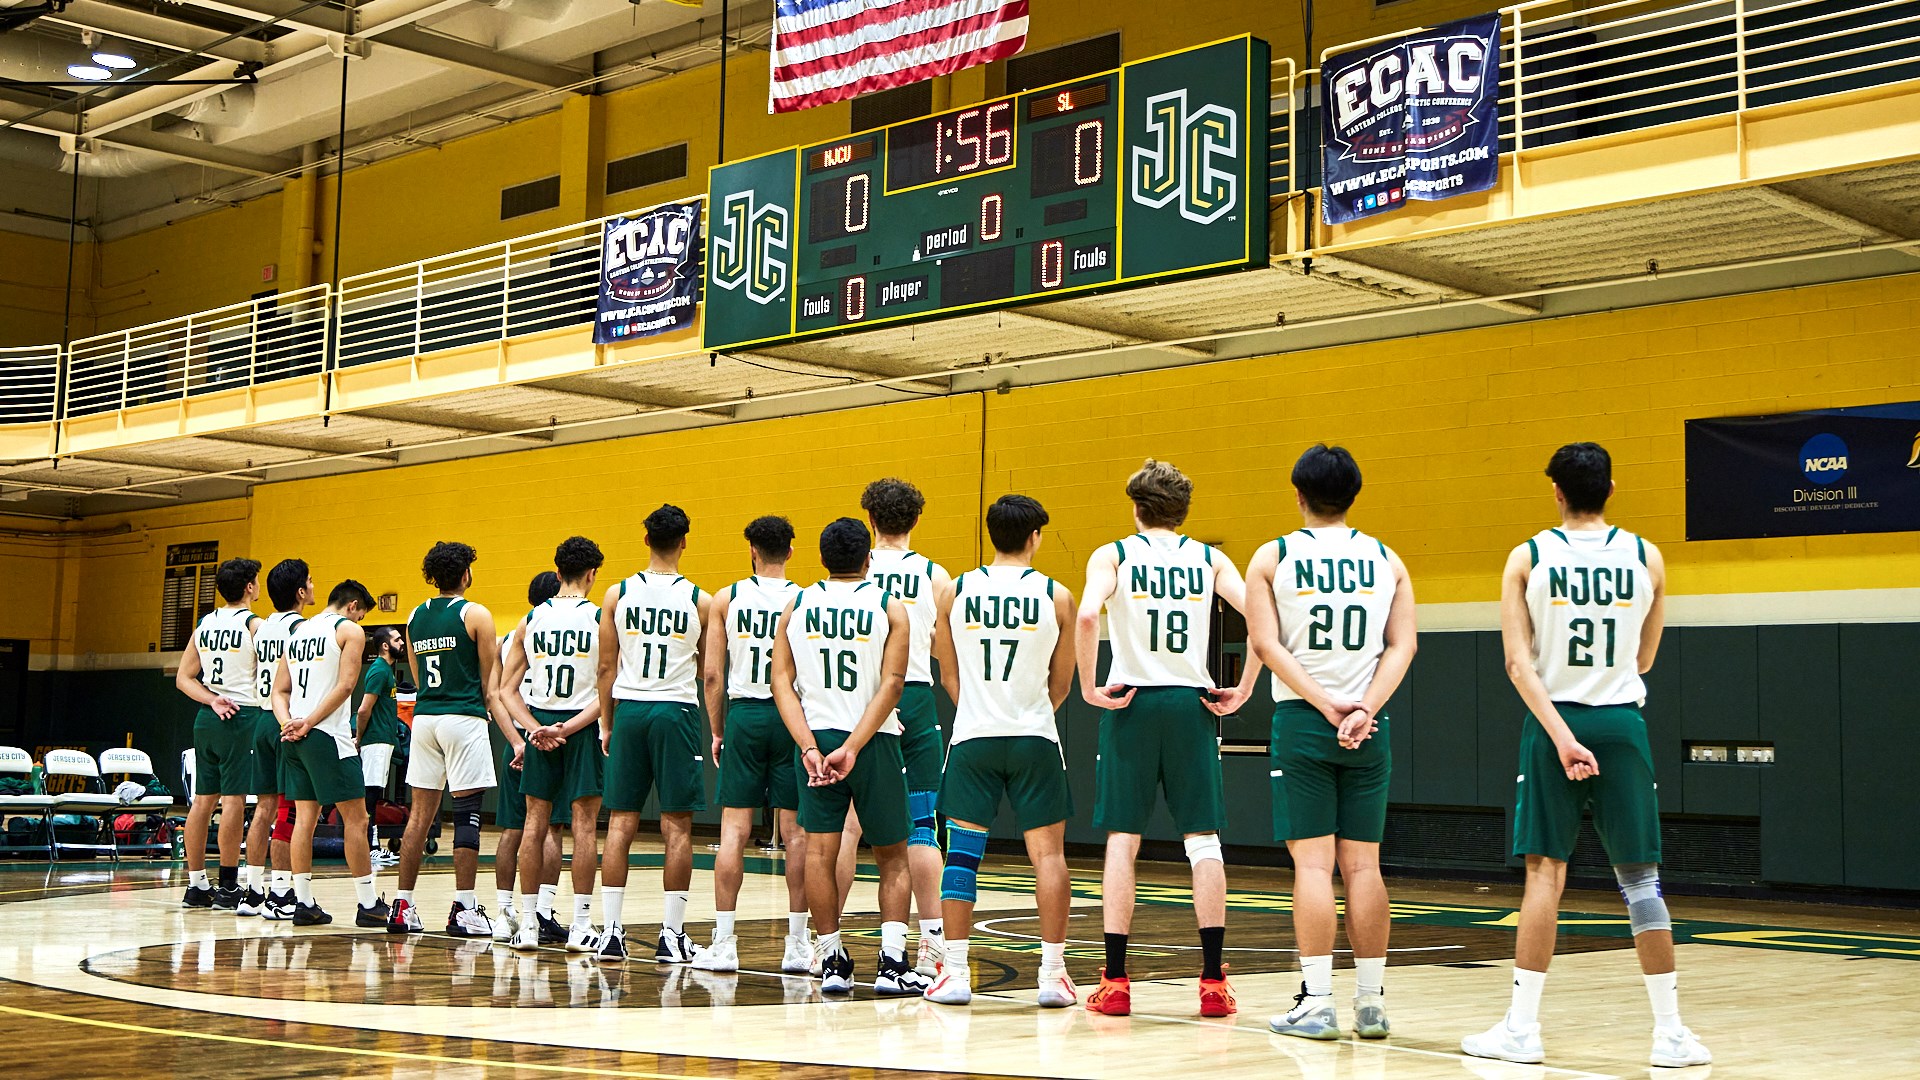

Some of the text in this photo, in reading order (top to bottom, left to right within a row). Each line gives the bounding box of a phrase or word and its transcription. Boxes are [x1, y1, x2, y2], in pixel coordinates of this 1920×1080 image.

[1057, 92, 1074, 112] SL
[1335, 42, 1482, 130] ECAC
[1346, 115, 1376, 137] EASTERN
[1376, 104, 1403, 121] COLLEGE
[936, 103, 1011, 174] 1:56
[1074, 120, 1102, 186] 0
[1362, 146, 1386, 155] HOME
[1404, 126, 1457, 144] AMPIONS
[824, 145, 852, 168] NJCU
[1132, 88, 1237, 225] JC
[1330, 146, 1488, 196] WWW.ECASPORTS.COM
[845, 173, 870, 232] 0
[981, 195, 1002, 240] 0
[607, 217, 689, 270] ECAC
[712, 189, 789, 305] JC
[926, 225, 967, 250] period
[1041, 240, 1062, 288] 0
[1073, 247, 1107, 270] fouls
[803, 296, 830, 317] fouls
[846, 277, 864, 320] 0
[882, 279, 922, 305] player
[1804, 456, 1848, 473] NCAA
[1774, 505, 1806, 513] DISCOVER
[1793, 486, 1857, 503] Division III
[873, 573, 920, 600] JCU
[1132, 564, 1203, 600] NJCU
[1295, 559, 1375, 594] NJCU
[1549, 566, 1634, 606] NJCU
[625, 606, 689, 637] NJCU
[737, 608, 782, 640] NJC
[806, 606, 873, 640] NJCU
[965, 595, 1039, 629] NJCU
[1308, 604, 1367, 651] 20
[199, 629, 243, 651] NJCU
[438, 636, 457, 649] CITY
[533, 629, 592, 657] NJCU
[1147, 609, 1189, 653] 18
[1567, 617, 1616, 667] 21
[288, 636, 327, 662] NJCU
[642, 642, 668, 679] 11
[980, 638, 1020, 682] 17
[210, 657, 223, 685] 2
[259, 669, 272, 697] 3
[298, 667, 309, 698] 4
[425, 654, 442, 688] 5
[545, 664, 575, 698] 10
[819, 648, 857, 692] 16
[11, 752, 26, 760] CITY
[52, 755, 76, 764] JERSEY
[107, 753, 146, 762] JERSEY CITY
